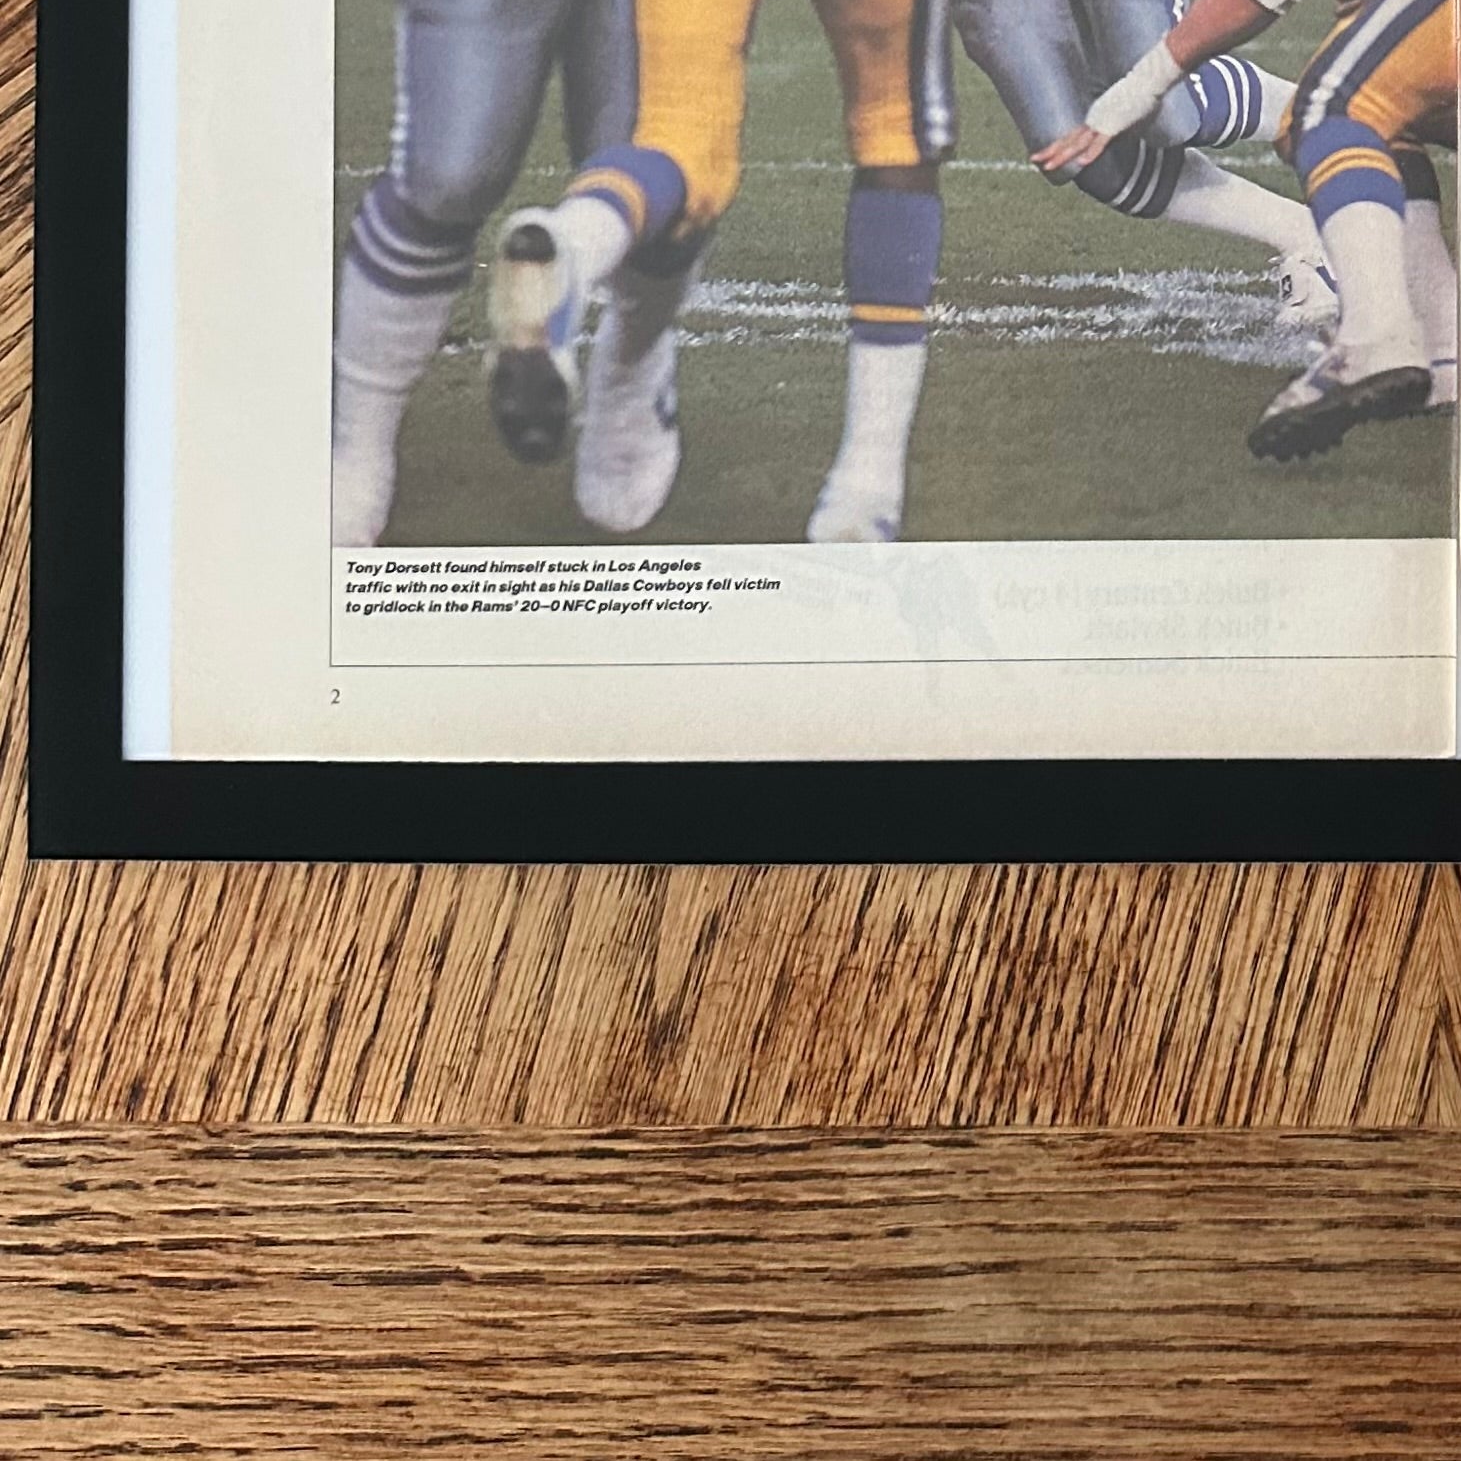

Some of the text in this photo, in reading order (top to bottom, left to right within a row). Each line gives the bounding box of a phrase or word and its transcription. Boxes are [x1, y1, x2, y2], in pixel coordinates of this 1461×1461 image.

[346, 558, 702, 577] Tony Dorsett found himself stuck in Los Angeles
[345, 577, 781, 596] traffic with no exit in sight as his Dallas Cowboys fell victim
[345, 598, 712, 616] to gridlock in the Rams’ 20–0 NFC playoff victory.
[330, 688, 340, 705] 2
